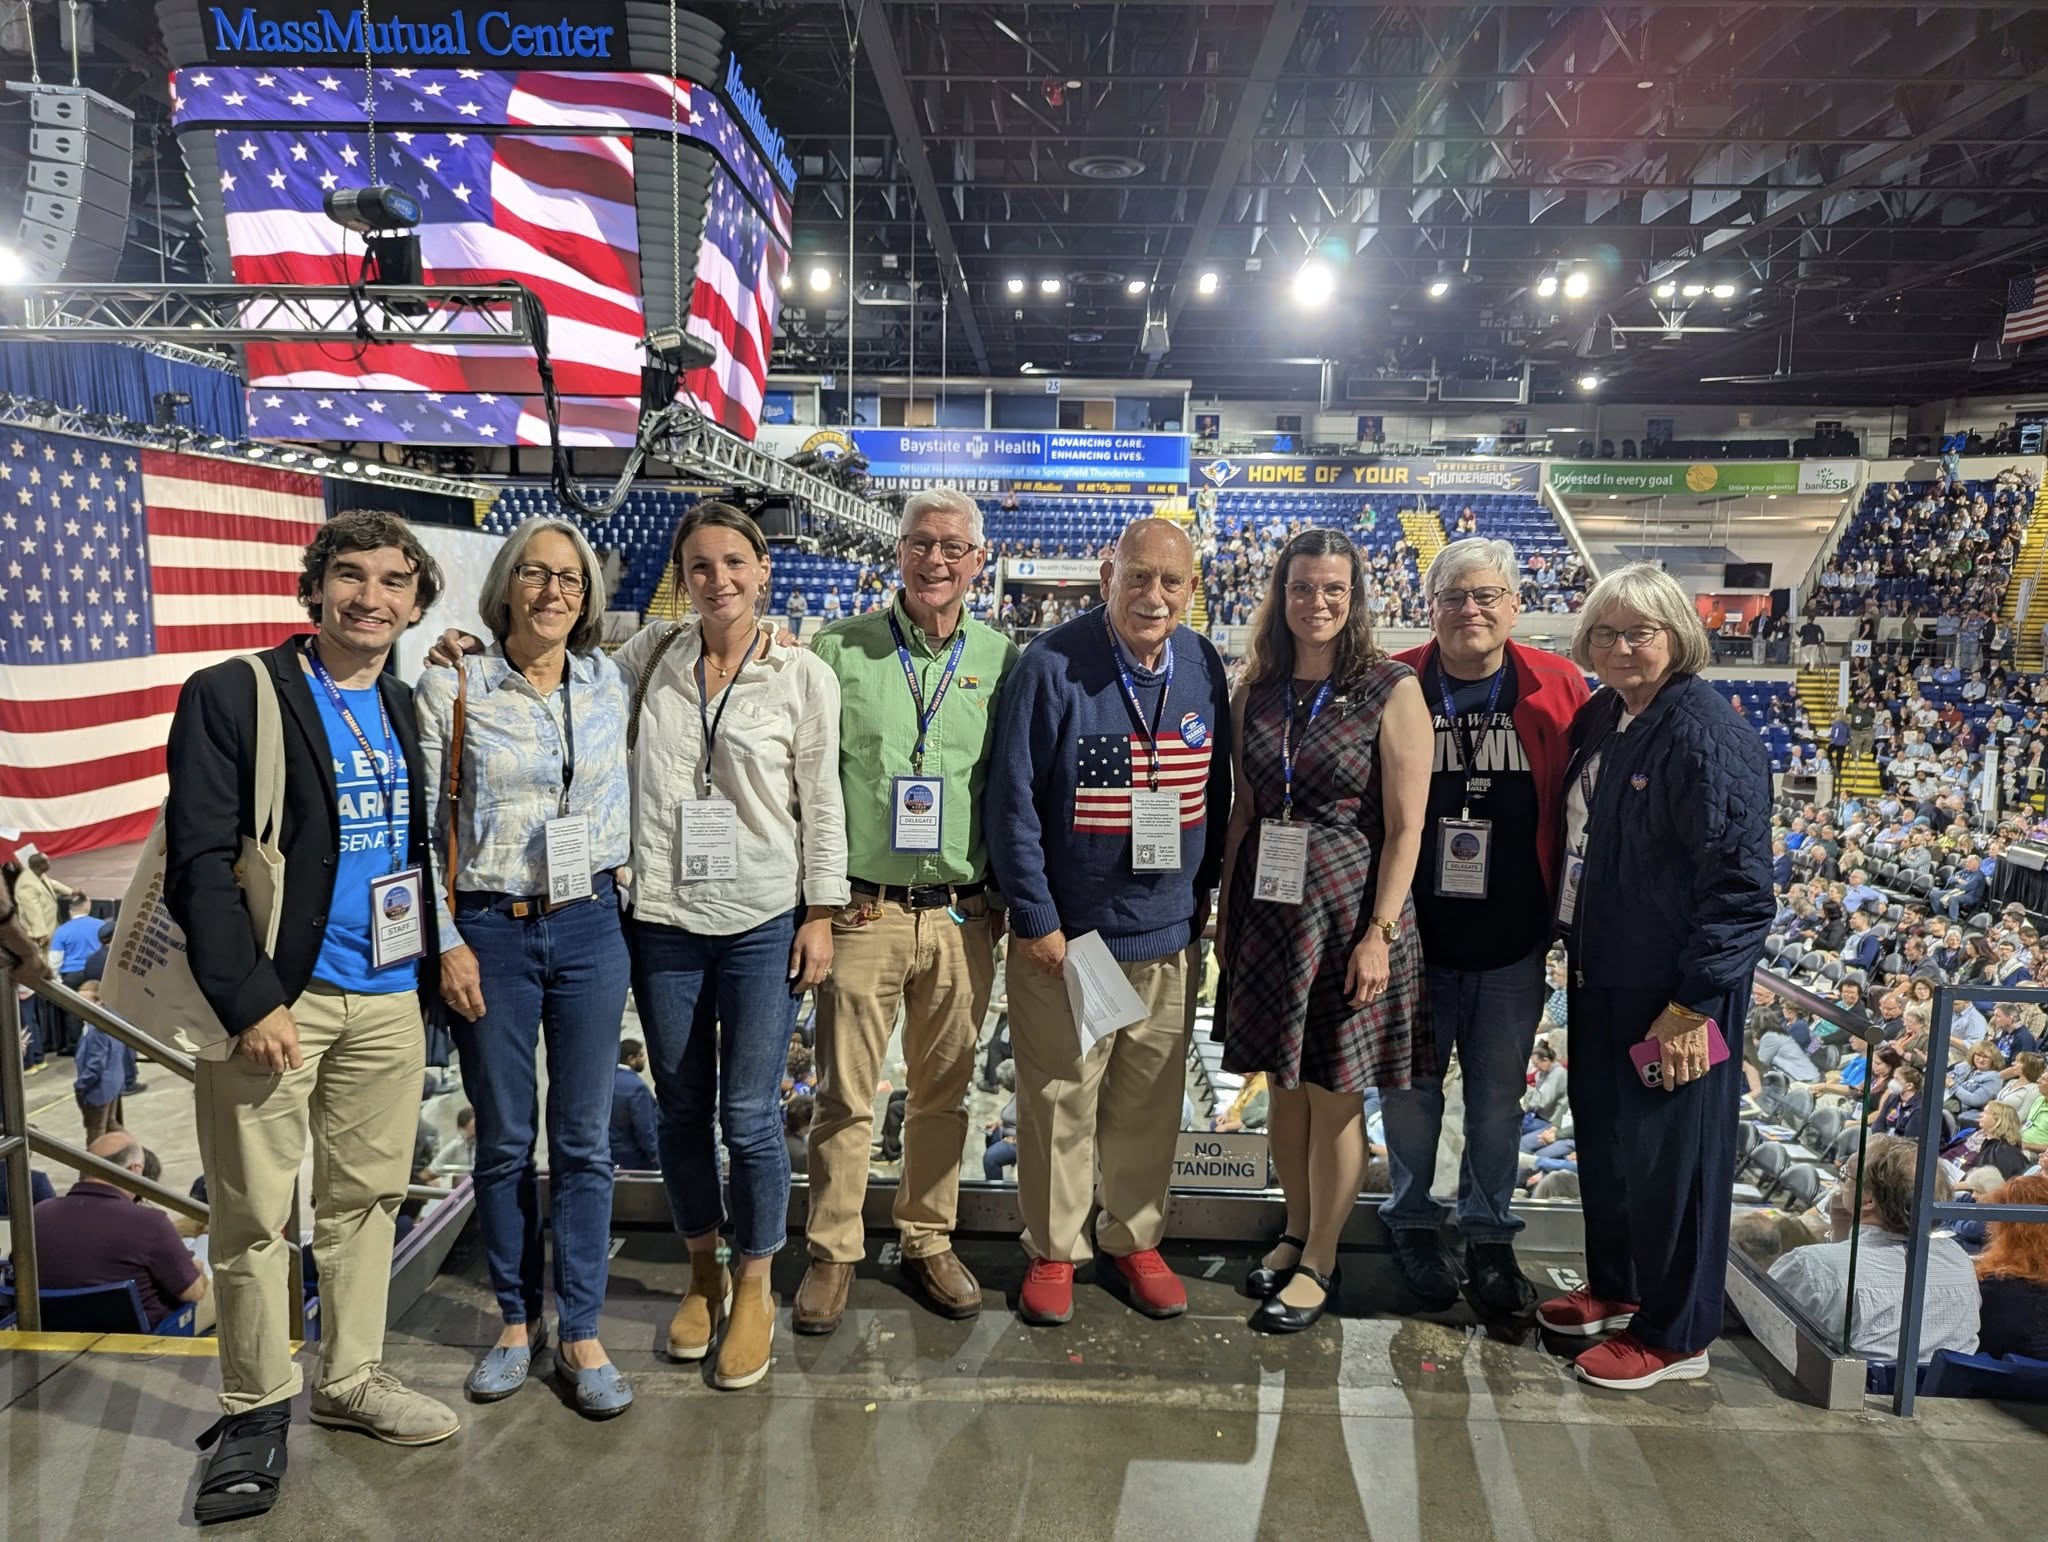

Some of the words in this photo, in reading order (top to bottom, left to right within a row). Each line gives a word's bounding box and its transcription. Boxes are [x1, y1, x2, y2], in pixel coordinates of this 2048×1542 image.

[209, 7, 470, 55] MassMutual
[477, 10, 614, 57] Center
[725, 51, 778, 162] MassMutual
[773, 136, 798, 195] Center
[1048, 380, 1059, 391] 25
[900, 437, 961, 455] Baystate
[994, 439, 1041, 454] Health
[1051, 437, 1112, 448] ADVANCING
[1115, 438, 1146, 449] CARE.
[1272, 435, 1294, 452] 26
[1471, 437, 1498, 453] 27
[1051, 450, 1111, 461] ENHANCING
[1113, 451, 1146, 462] LIVES.
[978, 467, 1012, 476] Provider
[1015, 466, 1025, 476] of
[1026, 467, 1041, 476] the
[1042, 467, 1089, 479] Springfield
[1090, 468, 1145, 479] Thunderbirds
[1248, 465, 1306, 482] HOME
[1315, 467, 1342, 483] OF
[1353, 467, 1409, 484] YOUR
[1436, 463, 1505, 471] SPRINGFIELD
[872, 477, 1000, 491] HUNDERBIRDS
[1428, 471, 1512, 489] THUNDERBIRDS
[1554, 473, 1600, 485] Invested
[1603, 473, 1613, 485] in
[1616, 476, 1647, 488] every
[1649, 474, 1673, 488] goal
[1766, 484, 1796, 492] potential
[1215, 632, 1226, 641] 26
[1855, 644, 1868, 653] 29
[342, 709, 363, 737] DRISCOLL
[1491, 712, 1514, 729] Fig
[1186, 724, 1206, 740] MARKEY
[351, 750, 390, 777] ED
[1470, 777, 1491, 788] ARRIS
[338, 790, 410, 819] ARKE
[388, 922, 411, 936] STAFF
[1194, 1142, 1222, 1157] NO
[1172, 1161, 1255, 1177] TANDING
